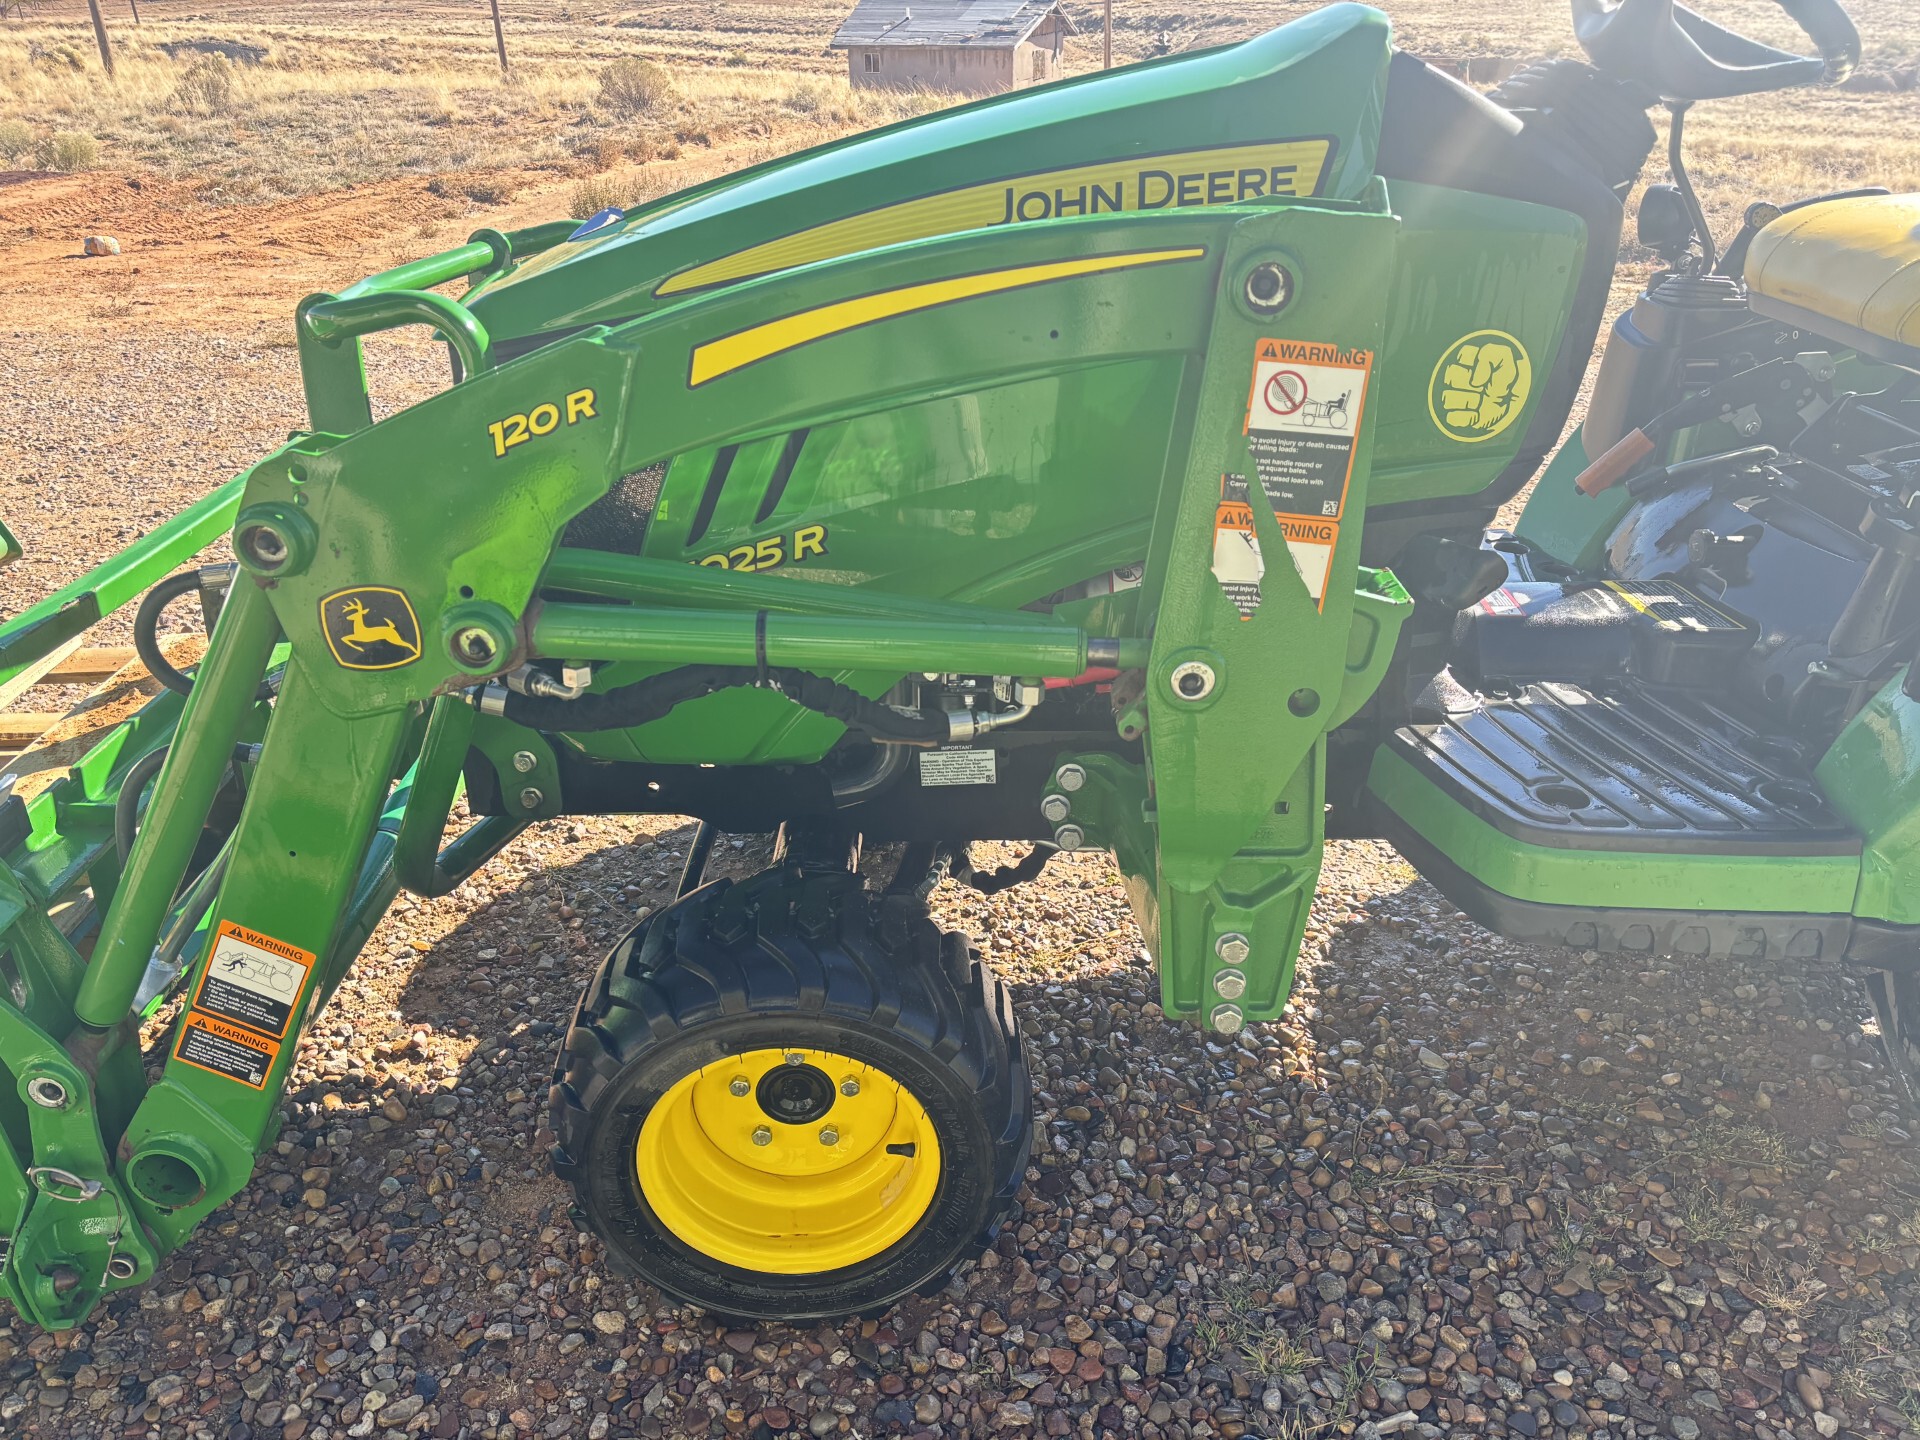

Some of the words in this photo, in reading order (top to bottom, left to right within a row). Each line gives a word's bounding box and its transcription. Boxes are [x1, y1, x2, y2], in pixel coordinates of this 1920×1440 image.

[986, 181, 1123, 226] JOHN
[1138, 165, 1298, 210] DEERE
[1280, 343, 1367, 366] WARNING
[487, 402, 560, 458] 120
[565, 387, 598, 425] R
[1257, 444, 1277, 452] falling
[1325, 443, 1350, 451] caused
[1230, 481, 1248, 489] Carry
[1270, 475, 1290, 483] raised
[1291, 477, 1308, 485] loads
[686, 536, 787, 573] 025
[793, 525, 829, 561] R
[245, 932, 304, 961] WARNING
[212, 1024, 269, 1050] WARNING
